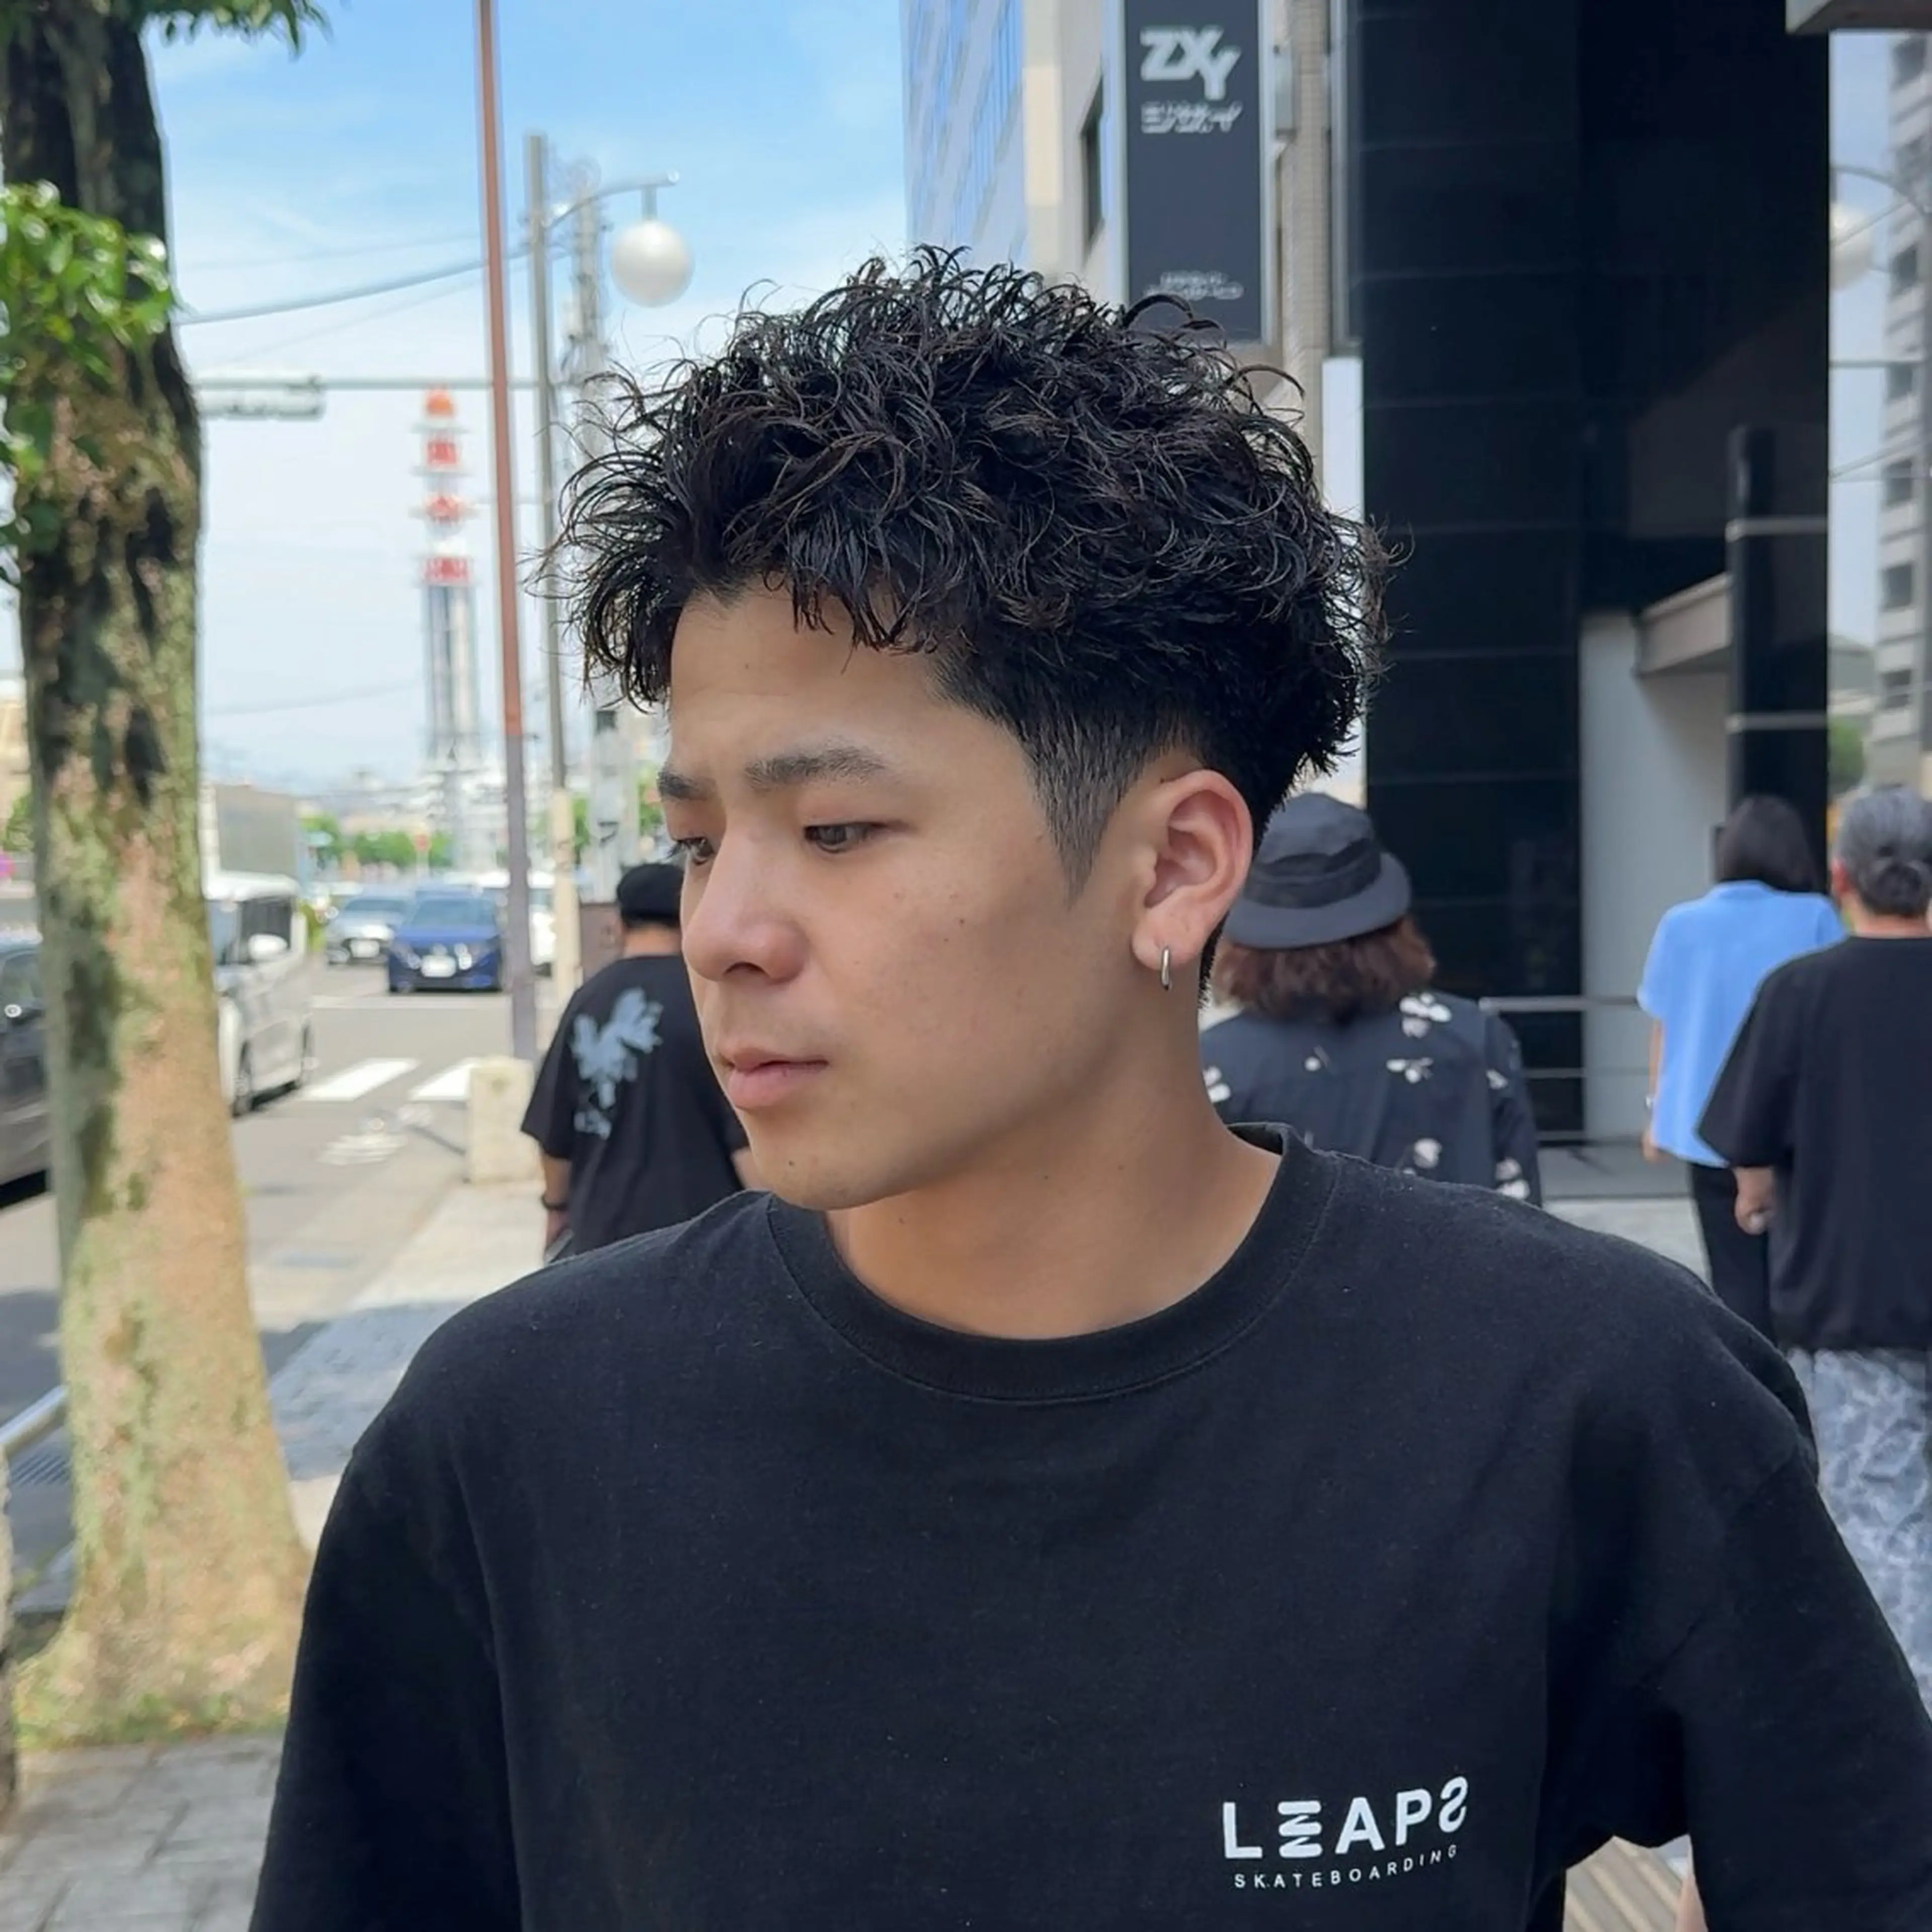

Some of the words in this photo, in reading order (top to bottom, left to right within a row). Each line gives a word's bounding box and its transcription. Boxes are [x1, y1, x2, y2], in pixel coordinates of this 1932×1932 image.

[1140, 26, 1241, 100] ZXY
[1223, 1776, 1468, 1859] LEAPS
[1234, 1844, 1457, 1888] SKATEBOARDING
